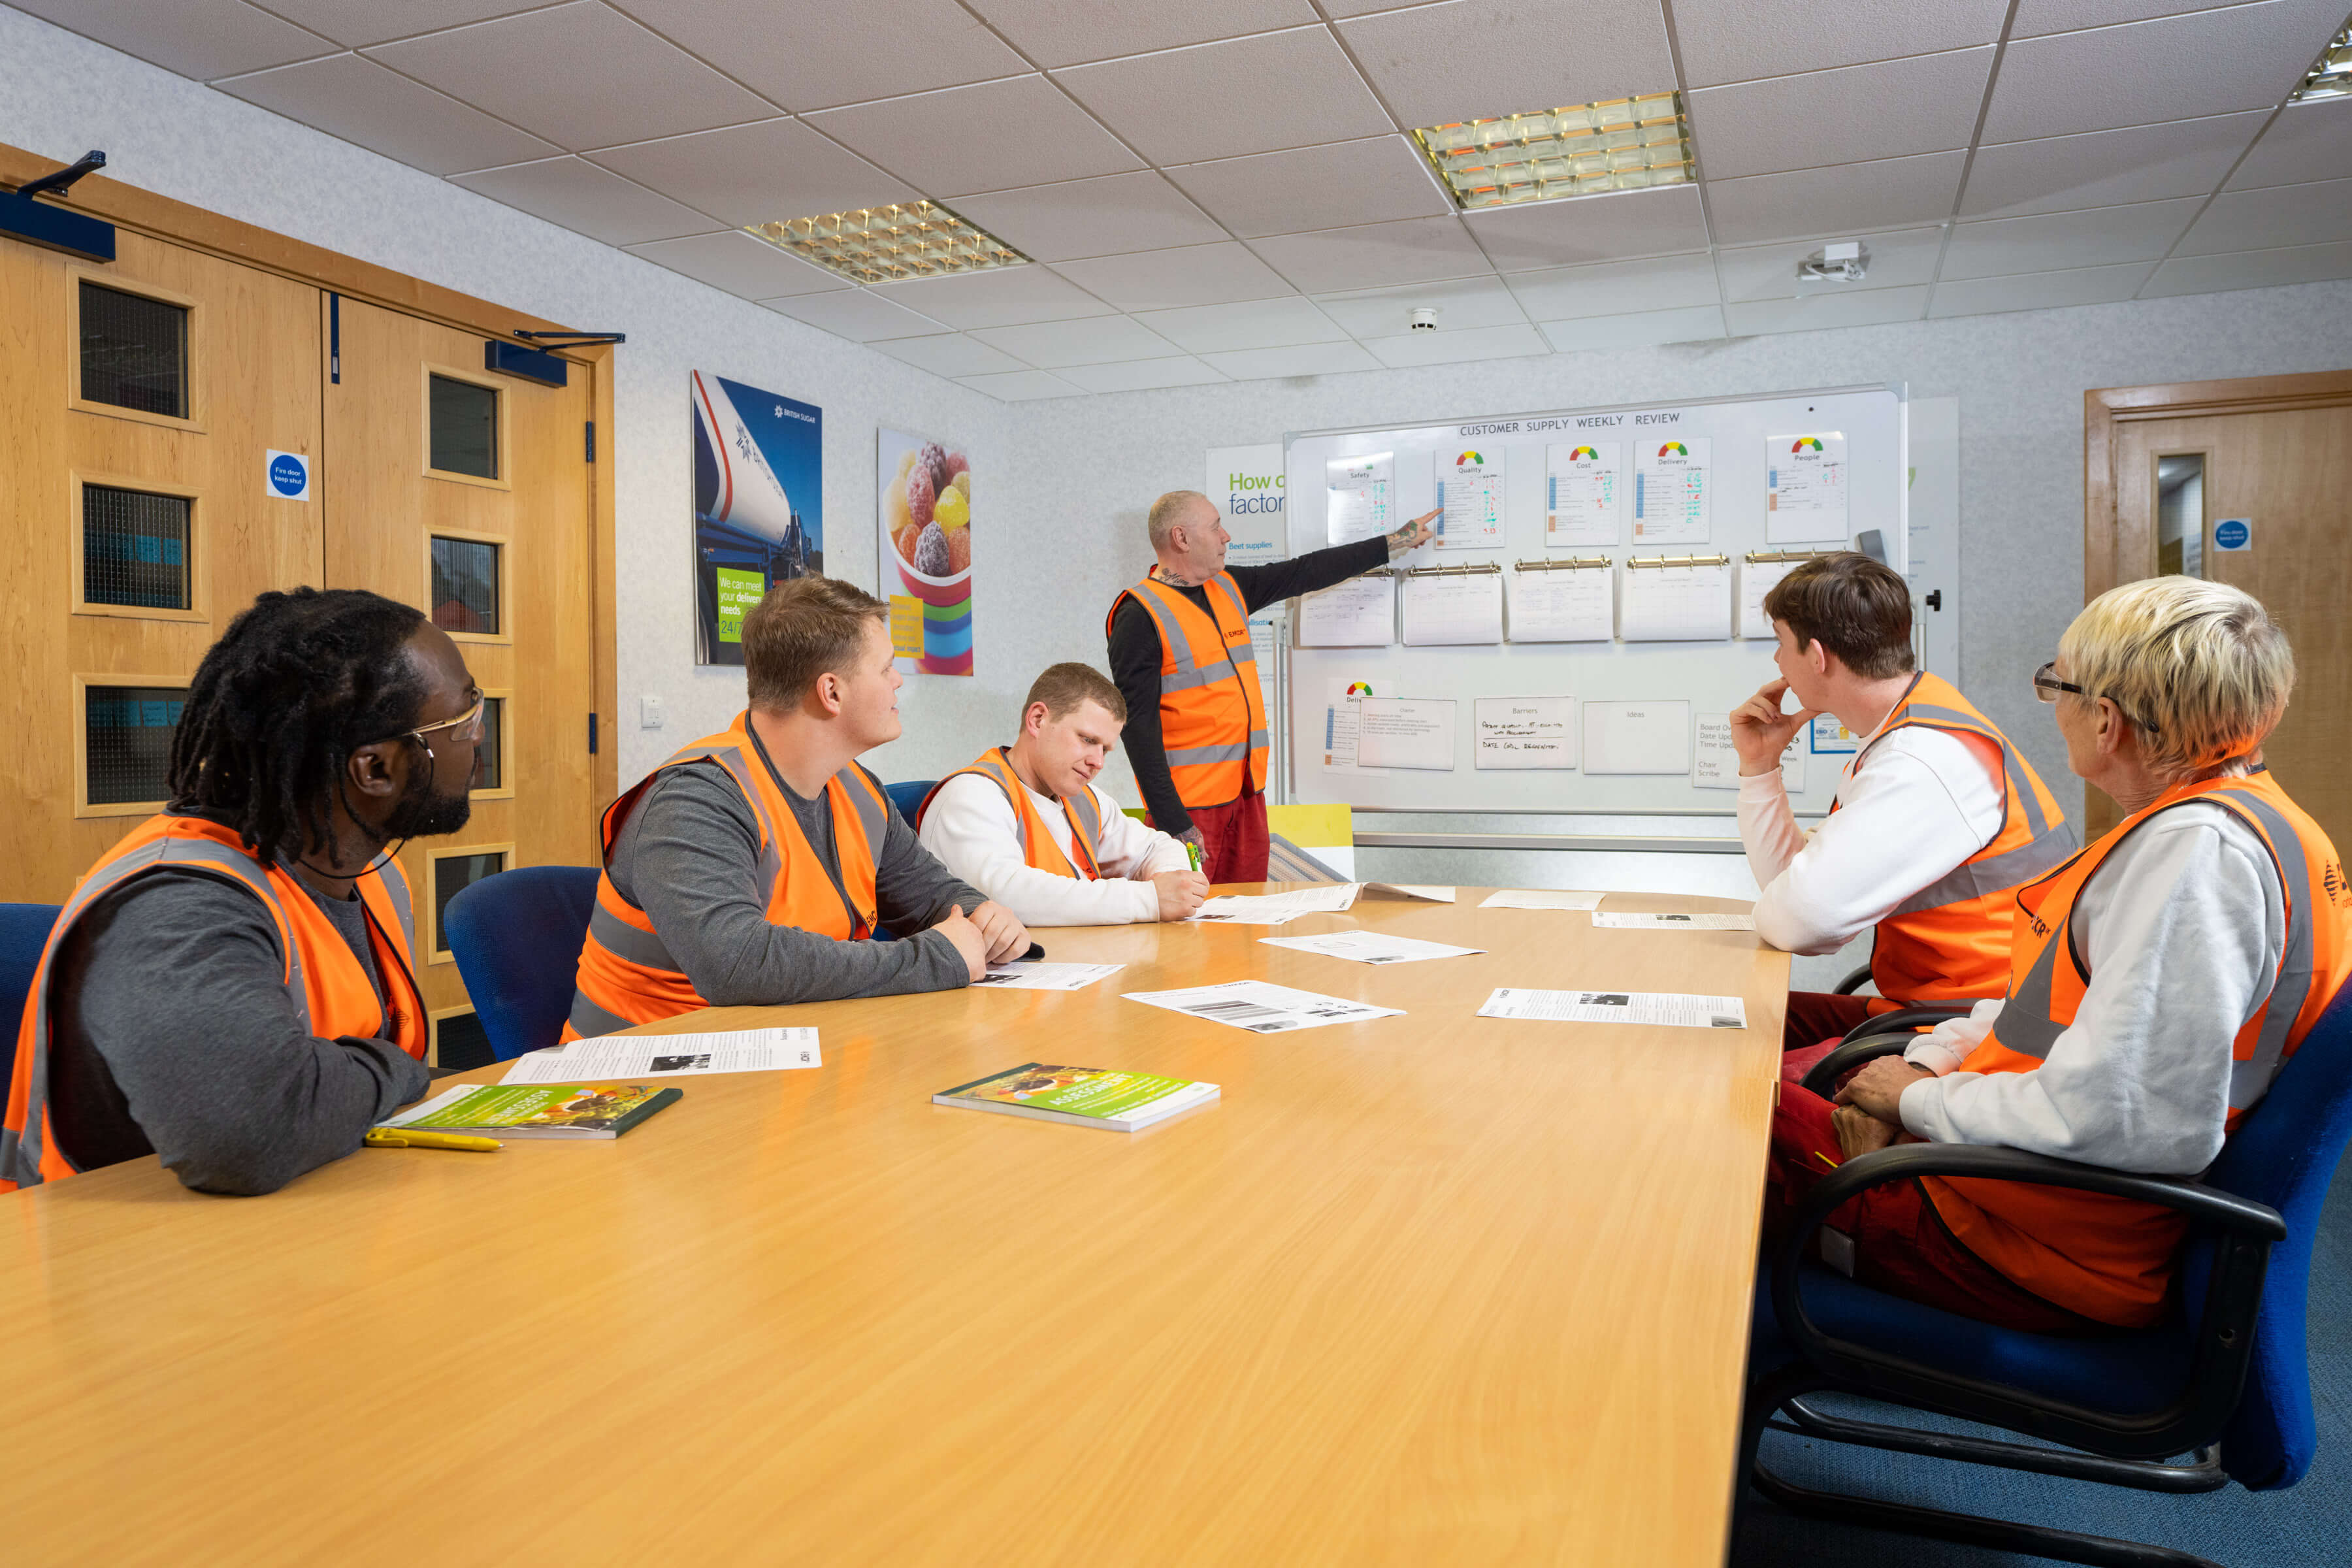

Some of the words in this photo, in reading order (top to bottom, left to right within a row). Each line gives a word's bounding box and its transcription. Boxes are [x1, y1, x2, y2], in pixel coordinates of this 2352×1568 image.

[784, 408, 800, 419] BRITISH
[800, 413, 815, 423] SUGAR
[1460, 423, 1519, 436] CUSTOMER
[1527, 419, 1569, 431] SUPPLY
[1577, 416, 1623, 427] WEEKLY
[1635, 413, 1680, 425] REVIEW
[274, 475, 288, 483] keep
[1230, 472, 1271, 491] How
[1229, 493, 1284, 515] factor
[1246, 541, 1273, 551] supplies
[720, 577, 731, 589] We
[732, 580, 744, 589] can
[745, 581, 762, 592] meet
[720, 592, 735, 602] your
[721, 604, 741, 615] needs
[1048, 1073, 1134, 1105] ASSESSMENT
[476, 1090, 554, 1124] ASSESSMENT
